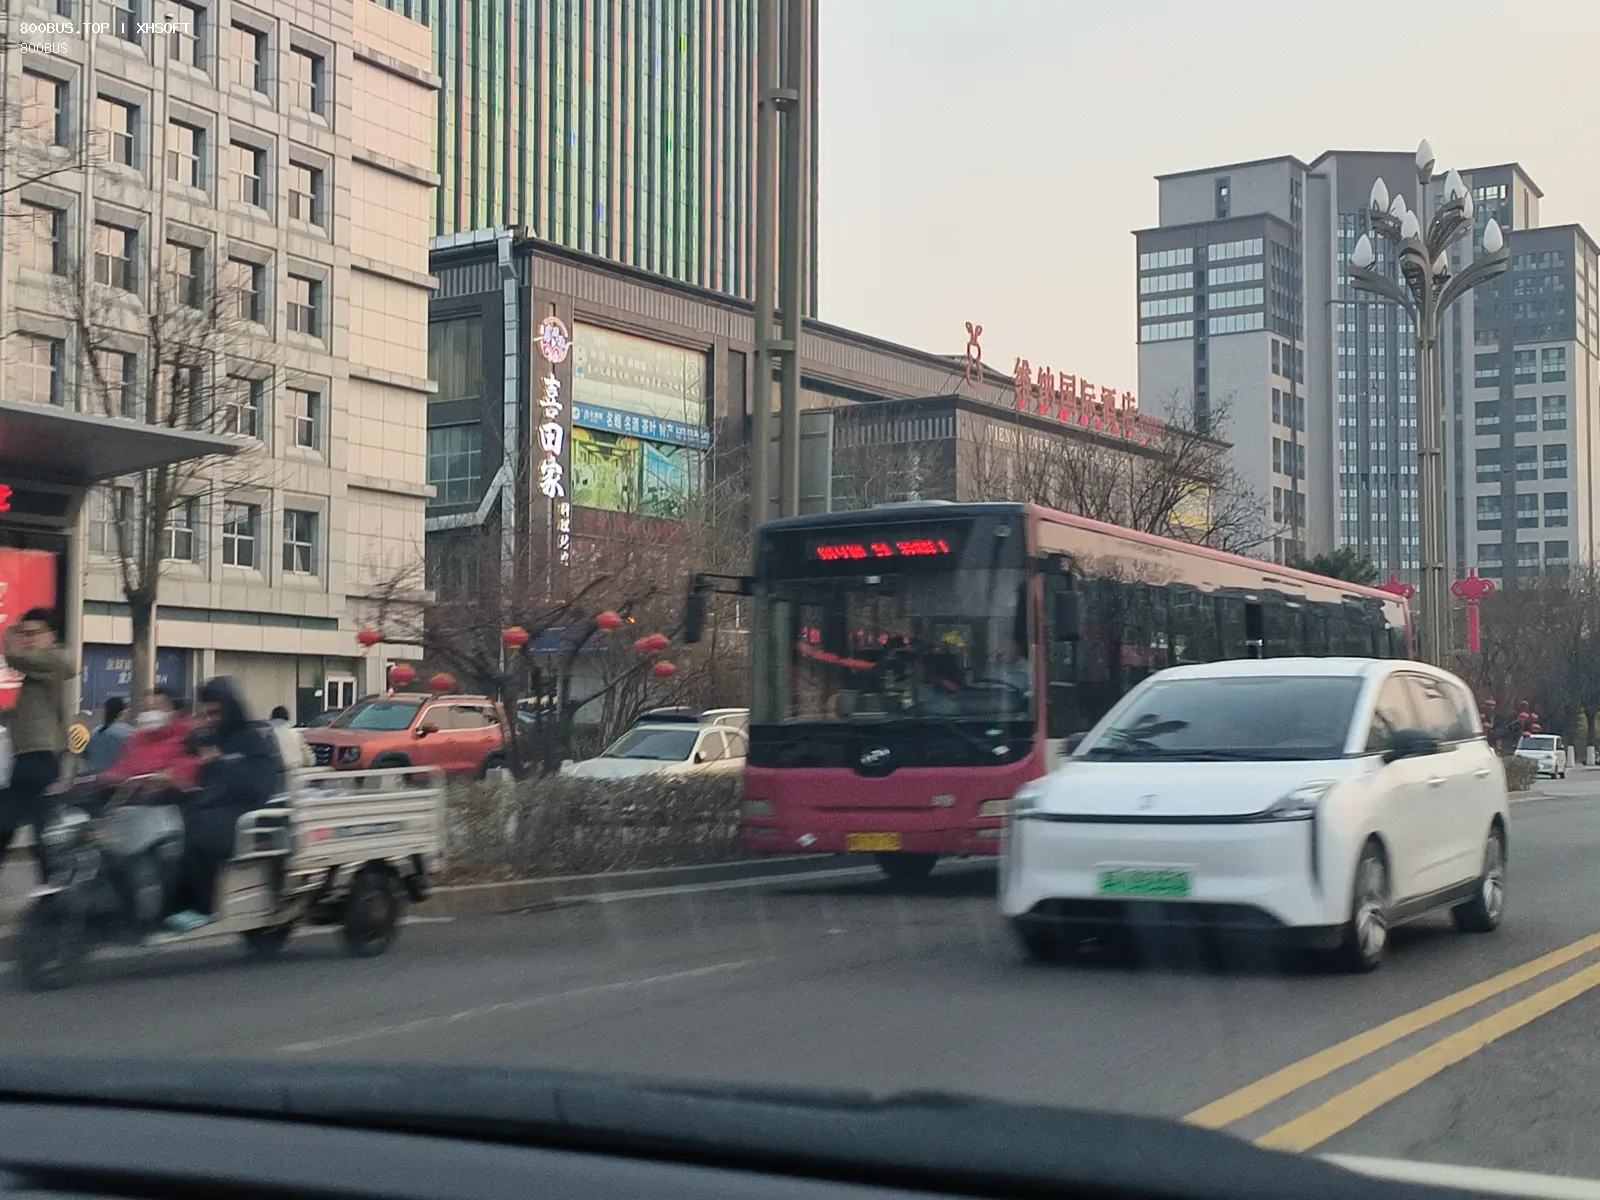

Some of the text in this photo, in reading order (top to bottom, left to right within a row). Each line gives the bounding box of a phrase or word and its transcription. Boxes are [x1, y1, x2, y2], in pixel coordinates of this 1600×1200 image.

[538, 372, 565, 498] 喜田家
[987, 424, 1024, 448] VIENNA
